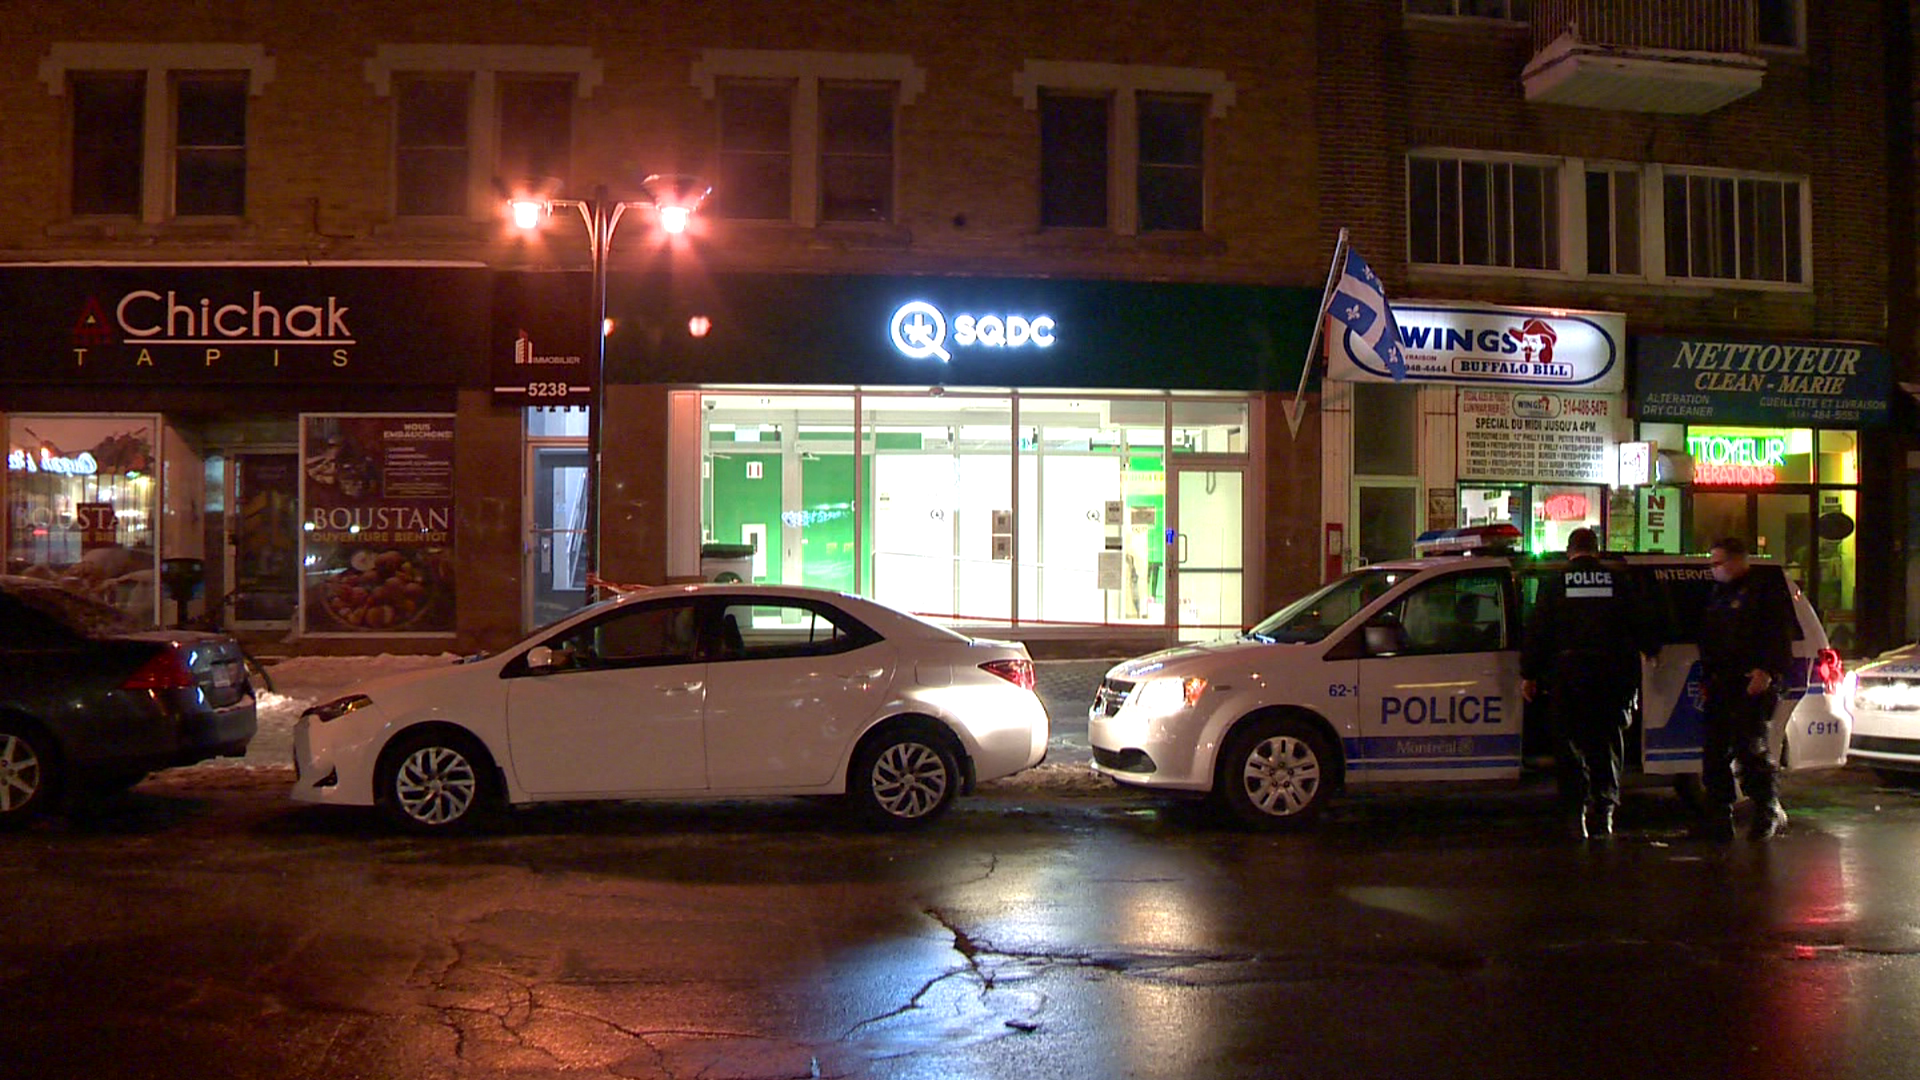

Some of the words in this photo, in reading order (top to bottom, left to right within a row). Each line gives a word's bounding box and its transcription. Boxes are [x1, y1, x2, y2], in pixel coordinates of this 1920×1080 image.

[116, 289, 351, 337] Chichak
[953, 314, 1057, 347] SQDC
[1400, 326, 1518, 354] WINGS
[73, 348, 348, 367] TAPIS
[1673, 341, 1861, 375] NETTOYEUR
[1460, 361, 1528, 375] BUFFALO
[1533, 362, 1568, 376] BILL
[528, 382, 567, 397] 5238
[1694, 371, 1764, 393] CLEAN
[1778, 374, 1846, 395] MARIE
[1646, 392, 1710, 405] ALTERATION
[1642, 405, 1664, 416] DRY
[1666, 405, 1713, 417] CLEANER
[1512, 418, 1523, 431] DU
[1579, 421, 1596, 433] 4PM
[1687, 436, 1786, 467] TTOYEUR
[1694, 465, 1776, 485] TERATIONS
[313, 507, 449, 530] BOUSTAN
[1565, 571, 1613, 585] POLICE
[1655, 568, 1714, 581] INTERVE
[1329, 684, 1358, 697] 62-1
[1380, 696, 1503, 725] POLICE
[1816, 721, 1839, 735] 911
